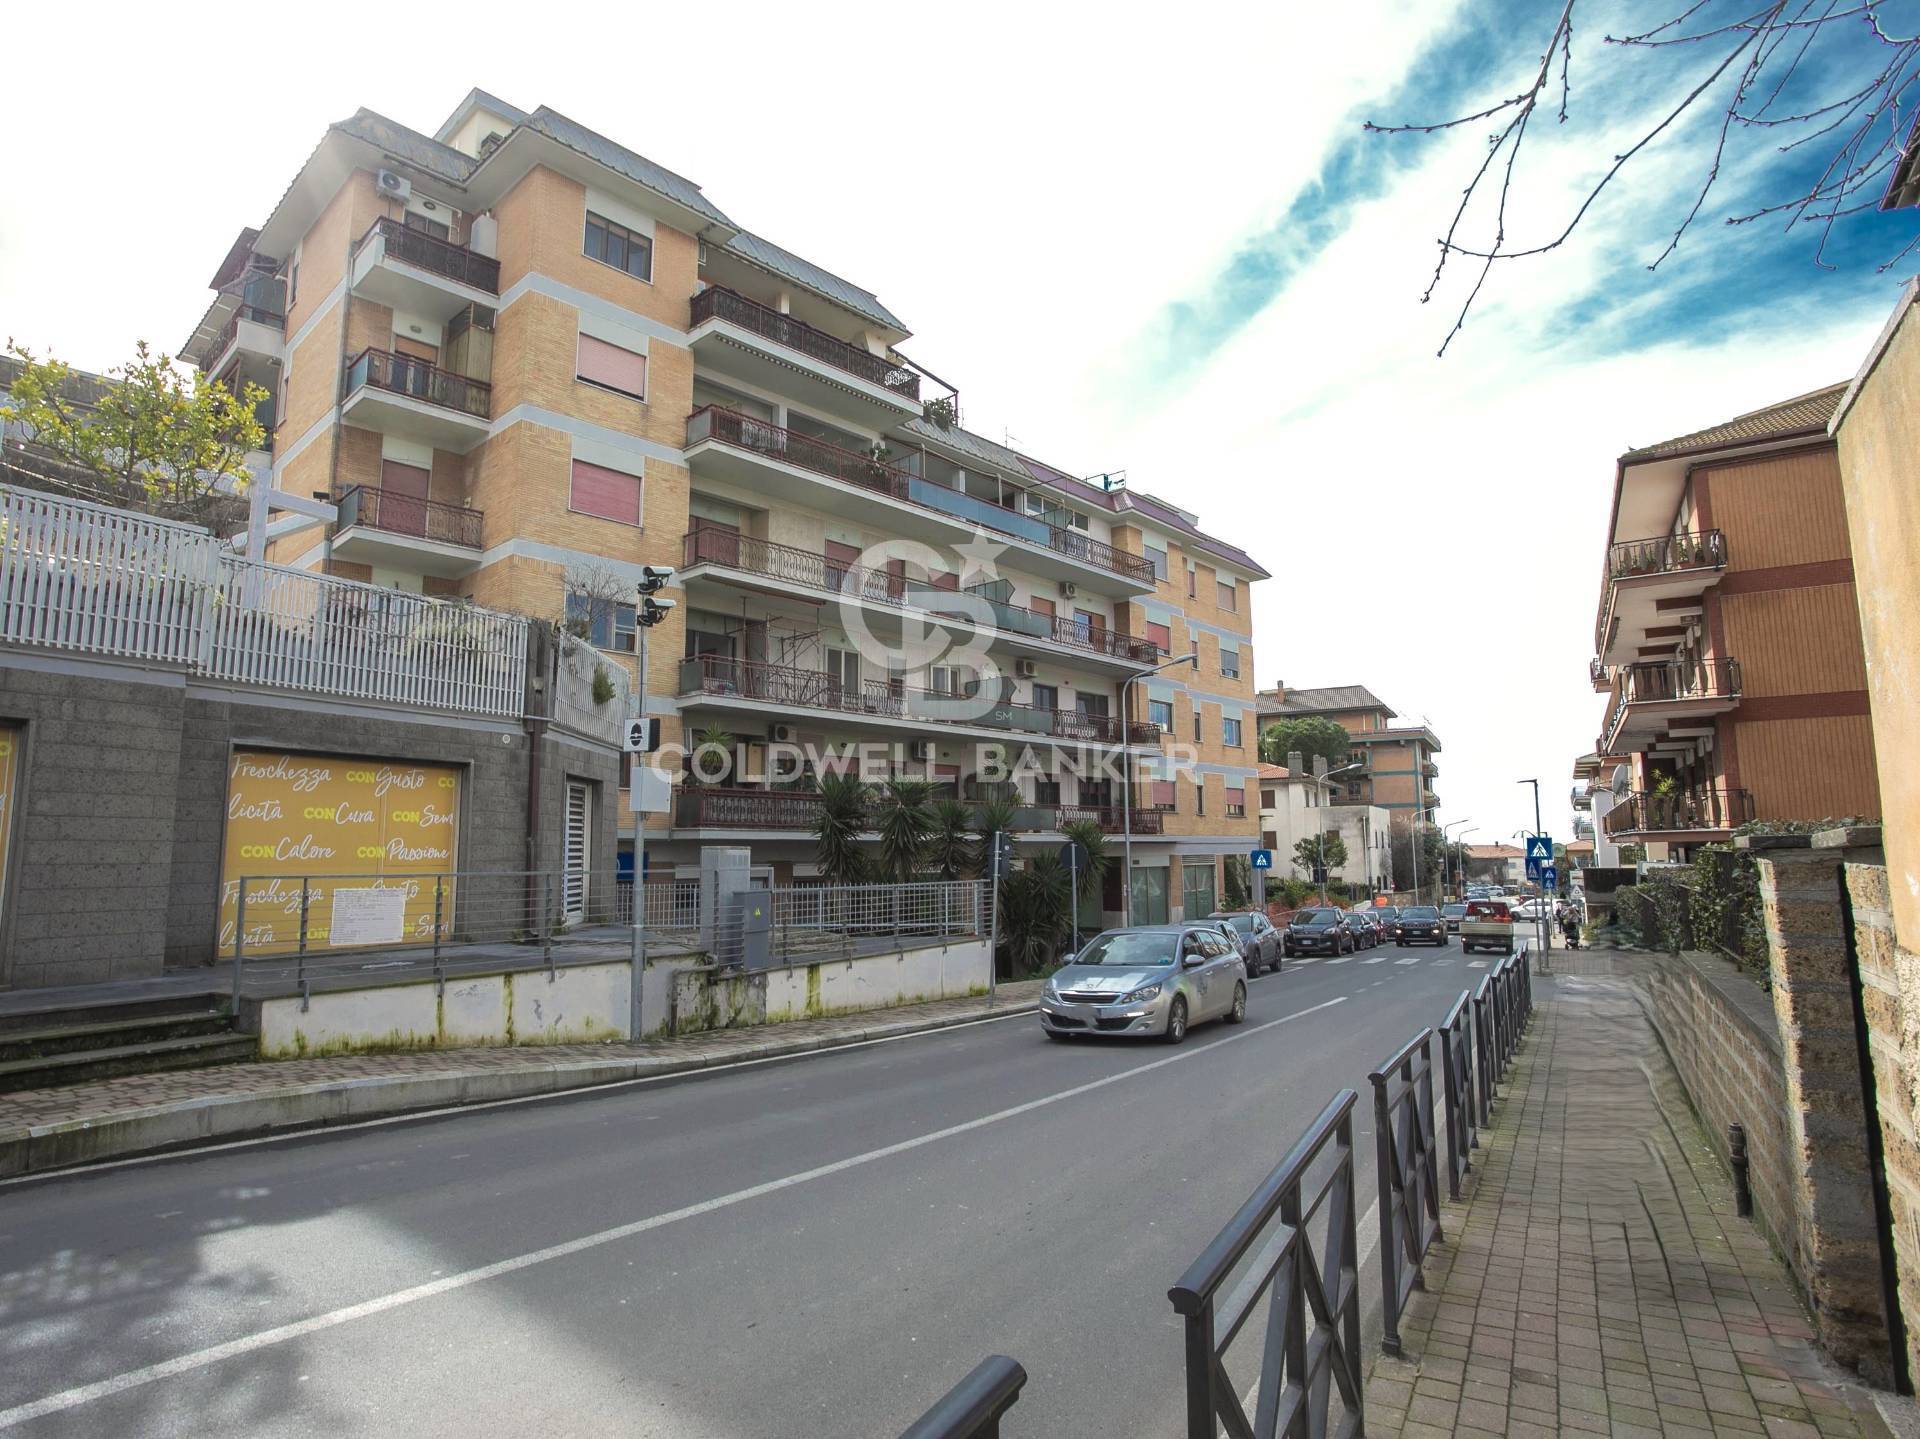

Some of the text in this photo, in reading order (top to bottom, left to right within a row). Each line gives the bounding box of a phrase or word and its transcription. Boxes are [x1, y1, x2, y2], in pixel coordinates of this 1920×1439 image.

[231, 753, 332, 792] Freschezza
[346, 770, 376, 784] CON
[375, 767, 427, 797] Gusto
[304, 807, 336, 820] CON
[336, 802, 375, 825] Cura
[392, 811, 420, 824] CON
[240, 834, 449, 861] CON Calore CON Passione
